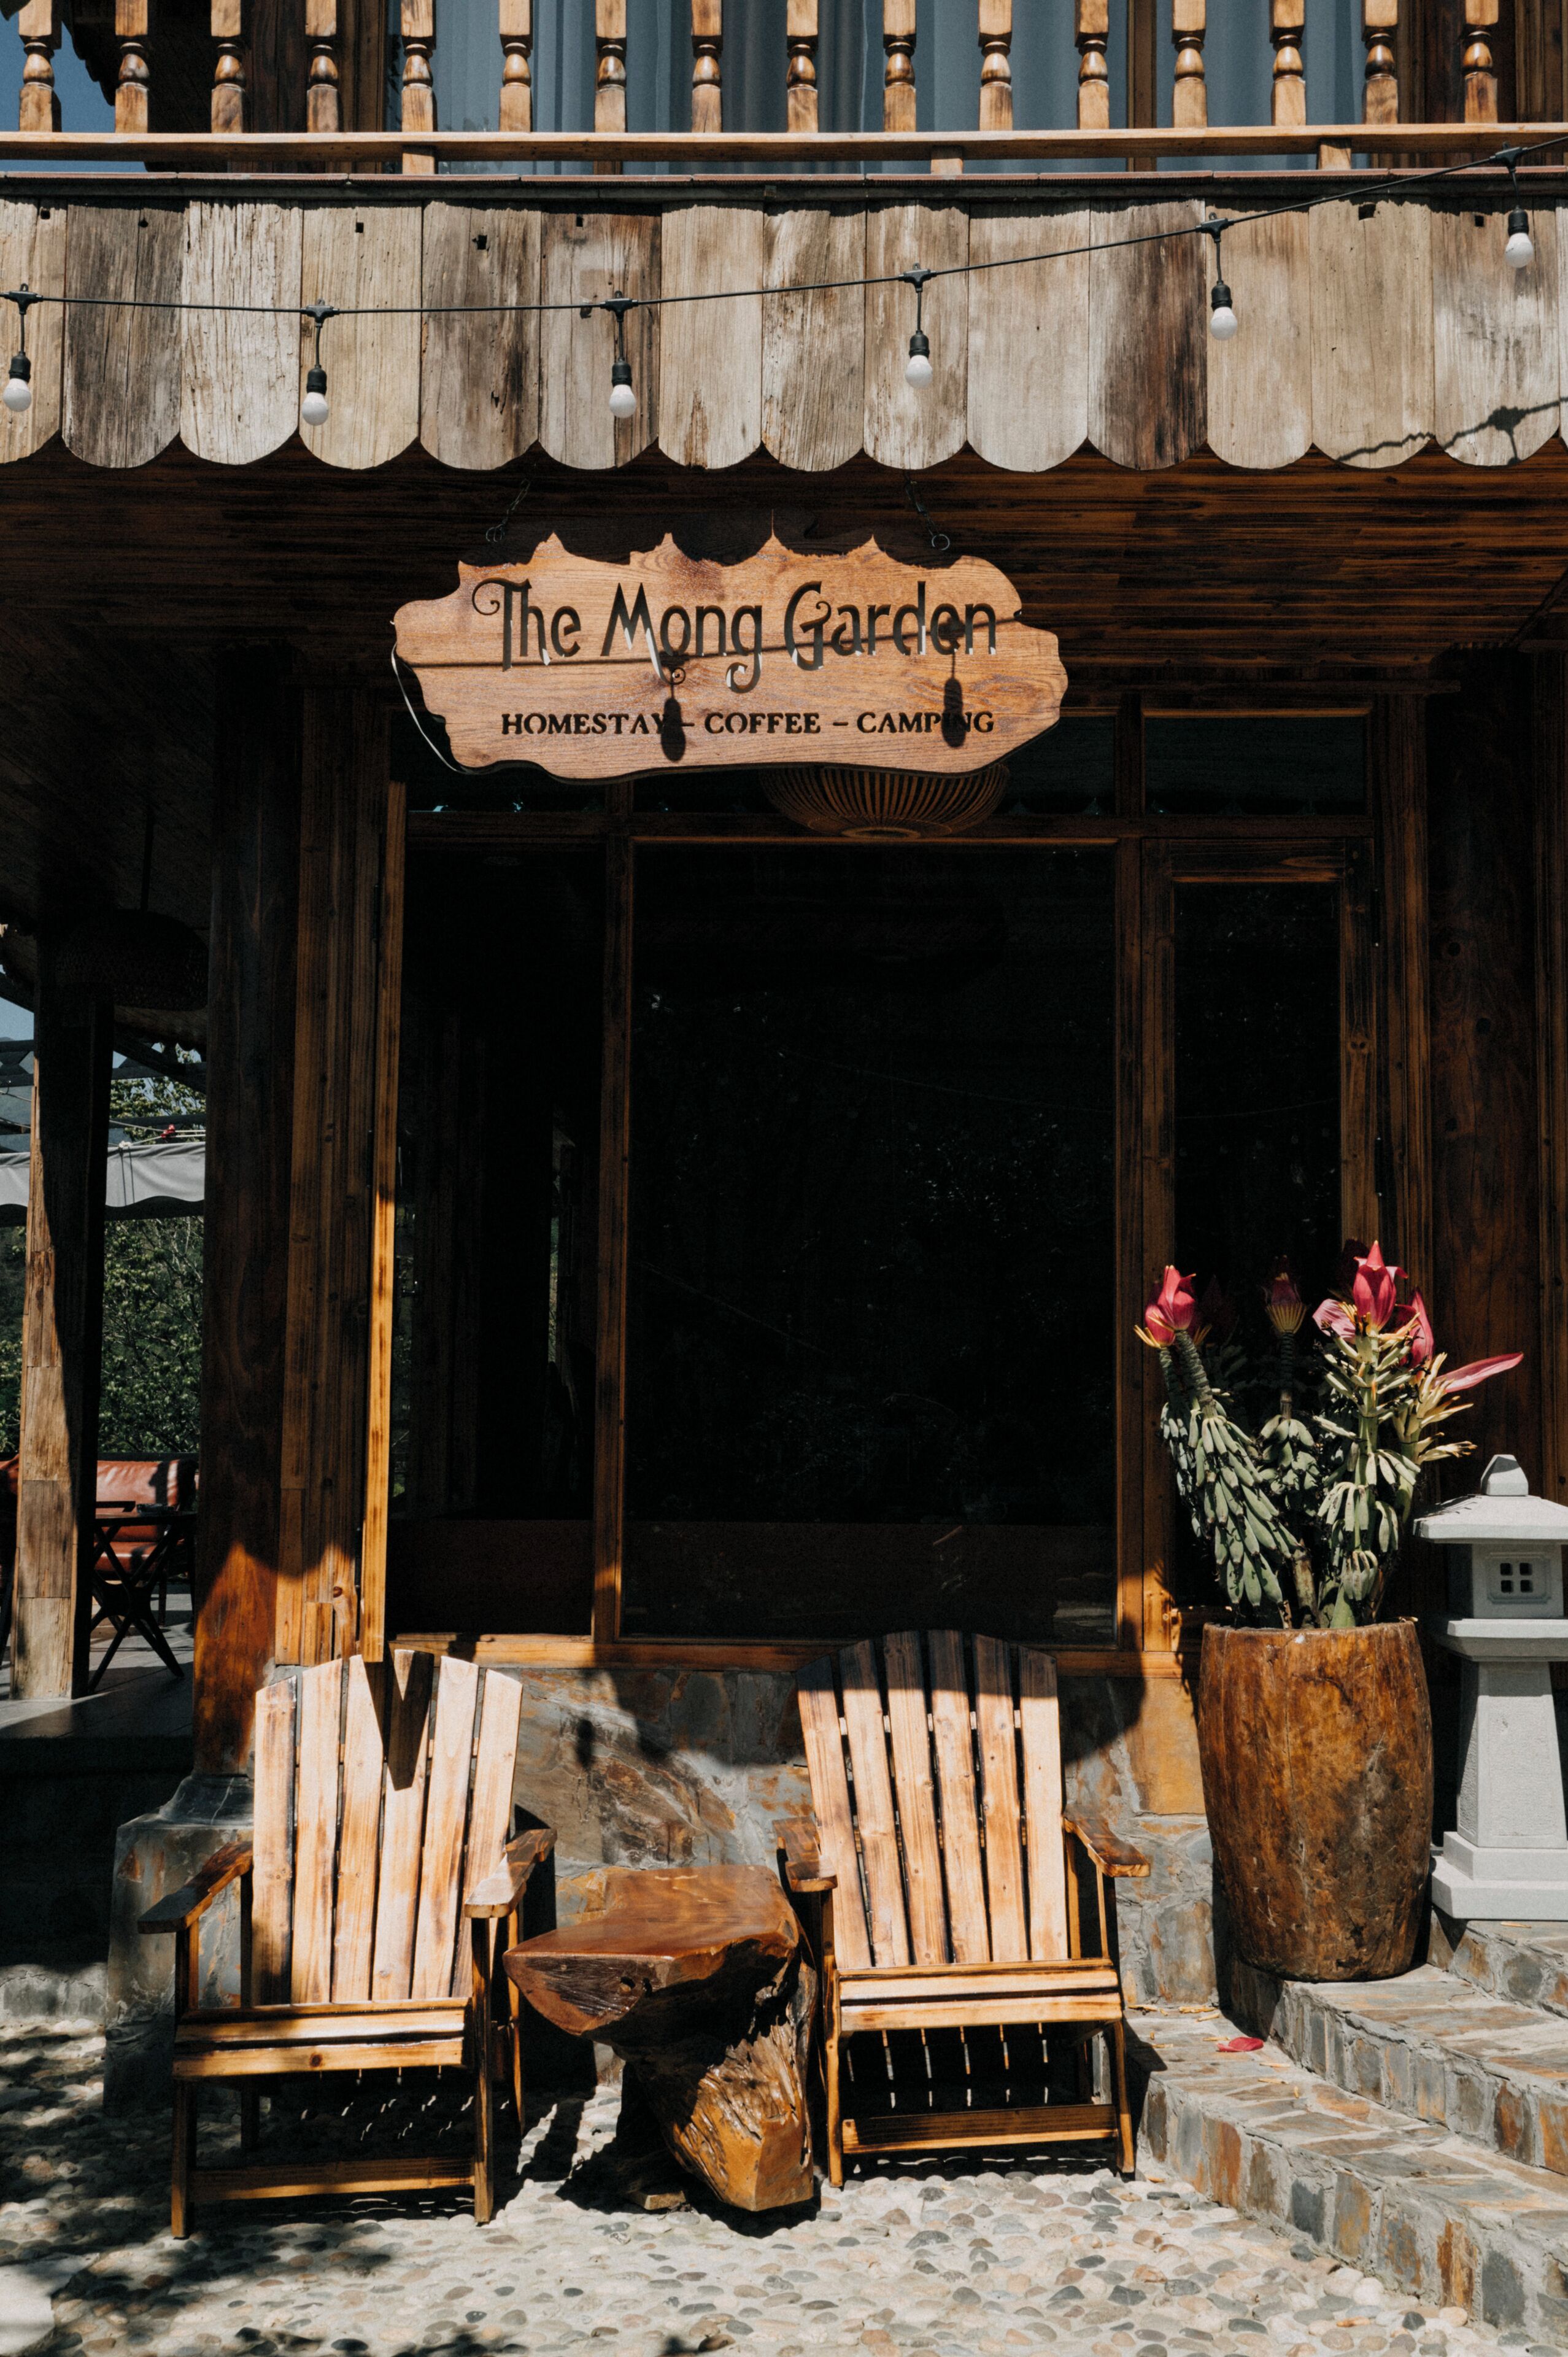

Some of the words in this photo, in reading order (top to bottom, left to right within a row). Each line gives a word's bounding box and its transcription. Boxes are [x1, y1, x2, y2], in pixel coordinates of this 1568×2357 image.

[471, 577, 582, 671] The
[600, 582, 763, 694] Mong
[784, 580, 997, 671] Garden
[501, 713, 669, 735] HOMESTAY
[704, 711, 821, 735] COFFEE
[857, 711, 994, 733] CAMPING
